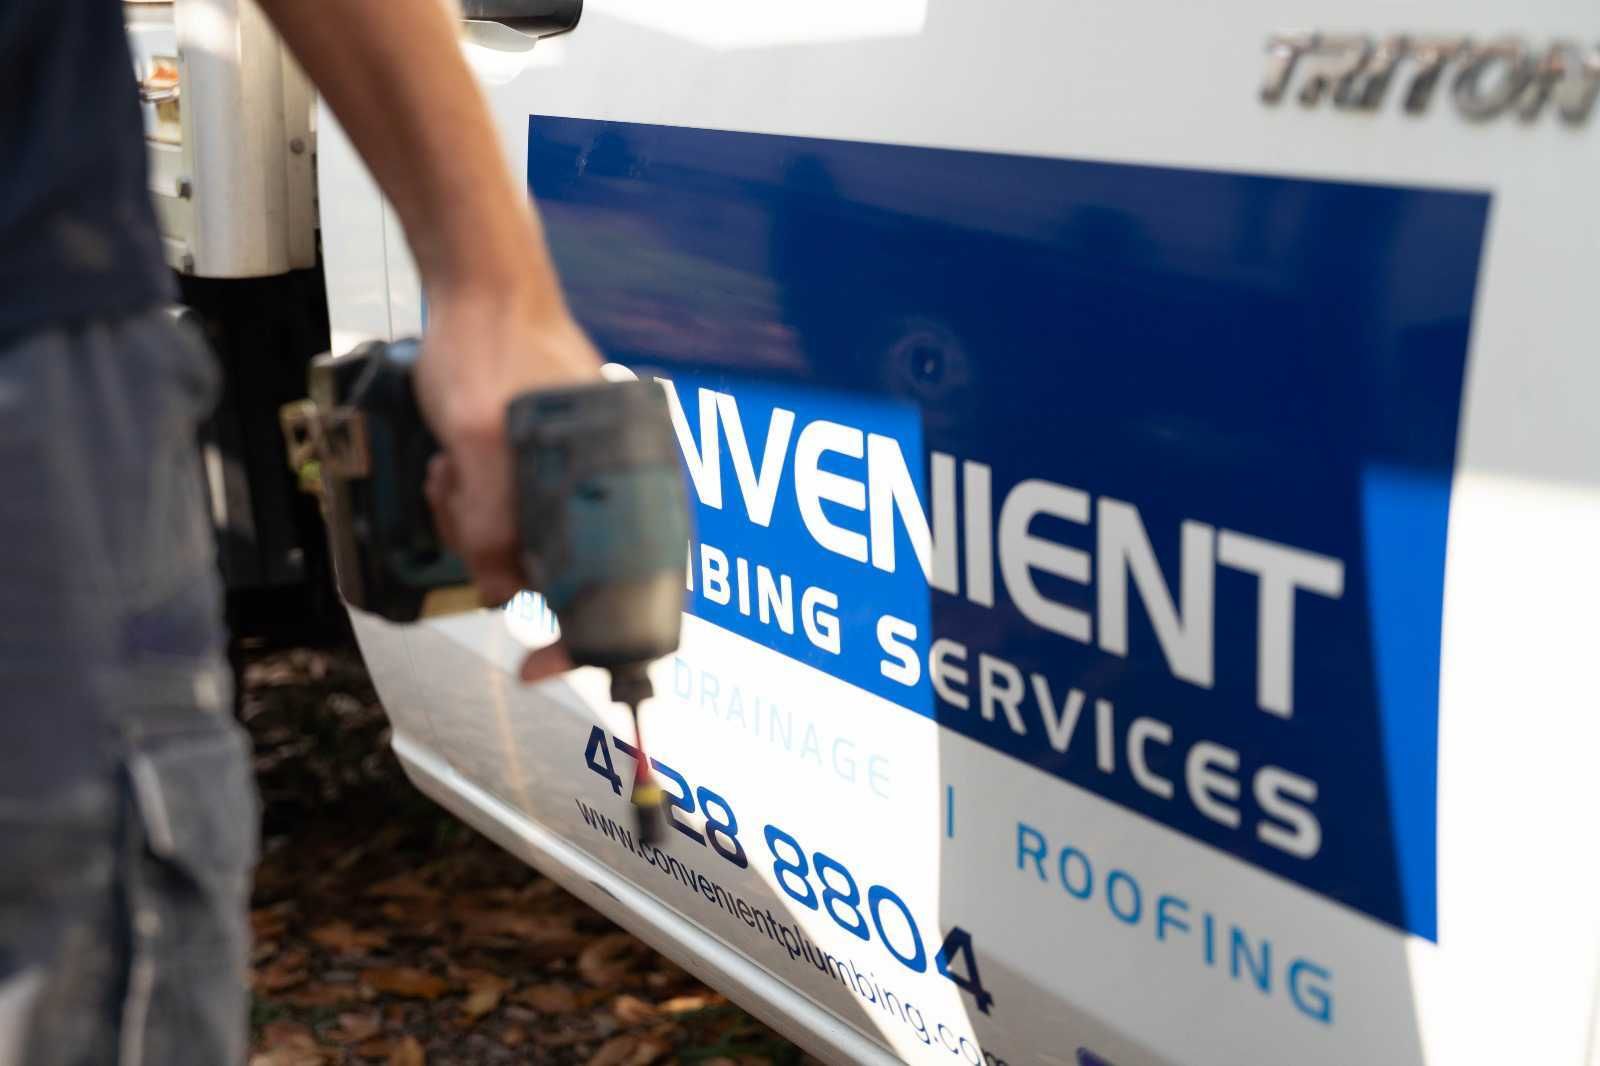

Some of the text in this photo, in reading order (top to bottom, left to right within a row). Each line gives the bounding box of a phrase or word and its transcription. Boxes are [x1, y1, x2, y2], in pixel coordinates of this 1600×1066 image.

[1260, 32, 1600, 128] TRITON
[600, 362, 1345, 720] NVENIENT
[686, 539, 1322, 859] BING SERVICES
[671, 656, 1335, 1024] DRAINAGE ROOFING
[763, 824, 995, 1016] 8804
